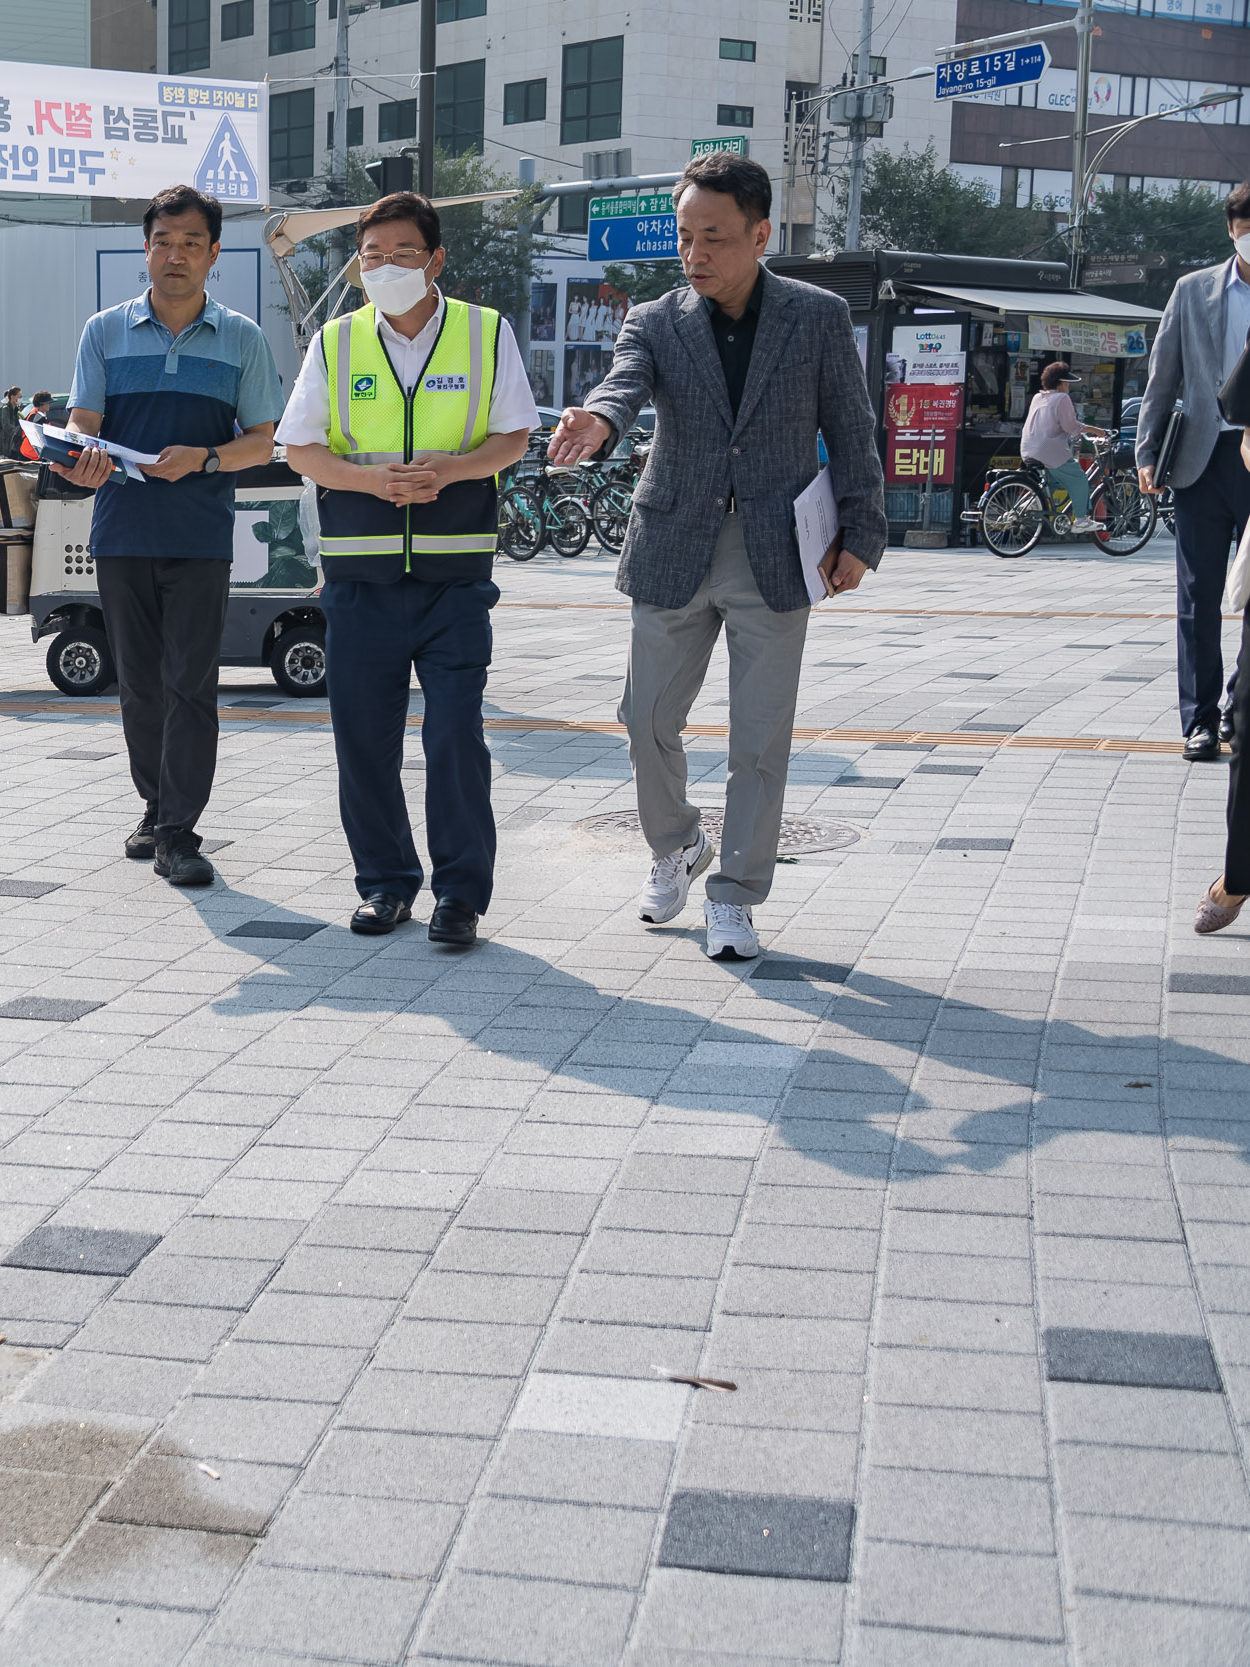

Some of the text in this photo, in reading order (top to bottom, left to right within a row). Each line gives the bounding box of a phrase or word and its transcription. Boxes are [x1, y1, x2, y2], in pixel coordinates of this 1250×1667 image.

[939, 51, 1016, 82] 자양로15길
[1030, 55, 1043, 64] 114
[938, 75, 997, 96] Jayang-ro 15-gil
[1048, 93, 1071, 107] GLEC
[916, 332, 936, 340] Lotto
[1044, 324, 1062, 348] 1등
[1100, 331, 1118, 354] 2등
[1127, 335, 1145, 351] 26
[895, 447, 946, 476] 담배
